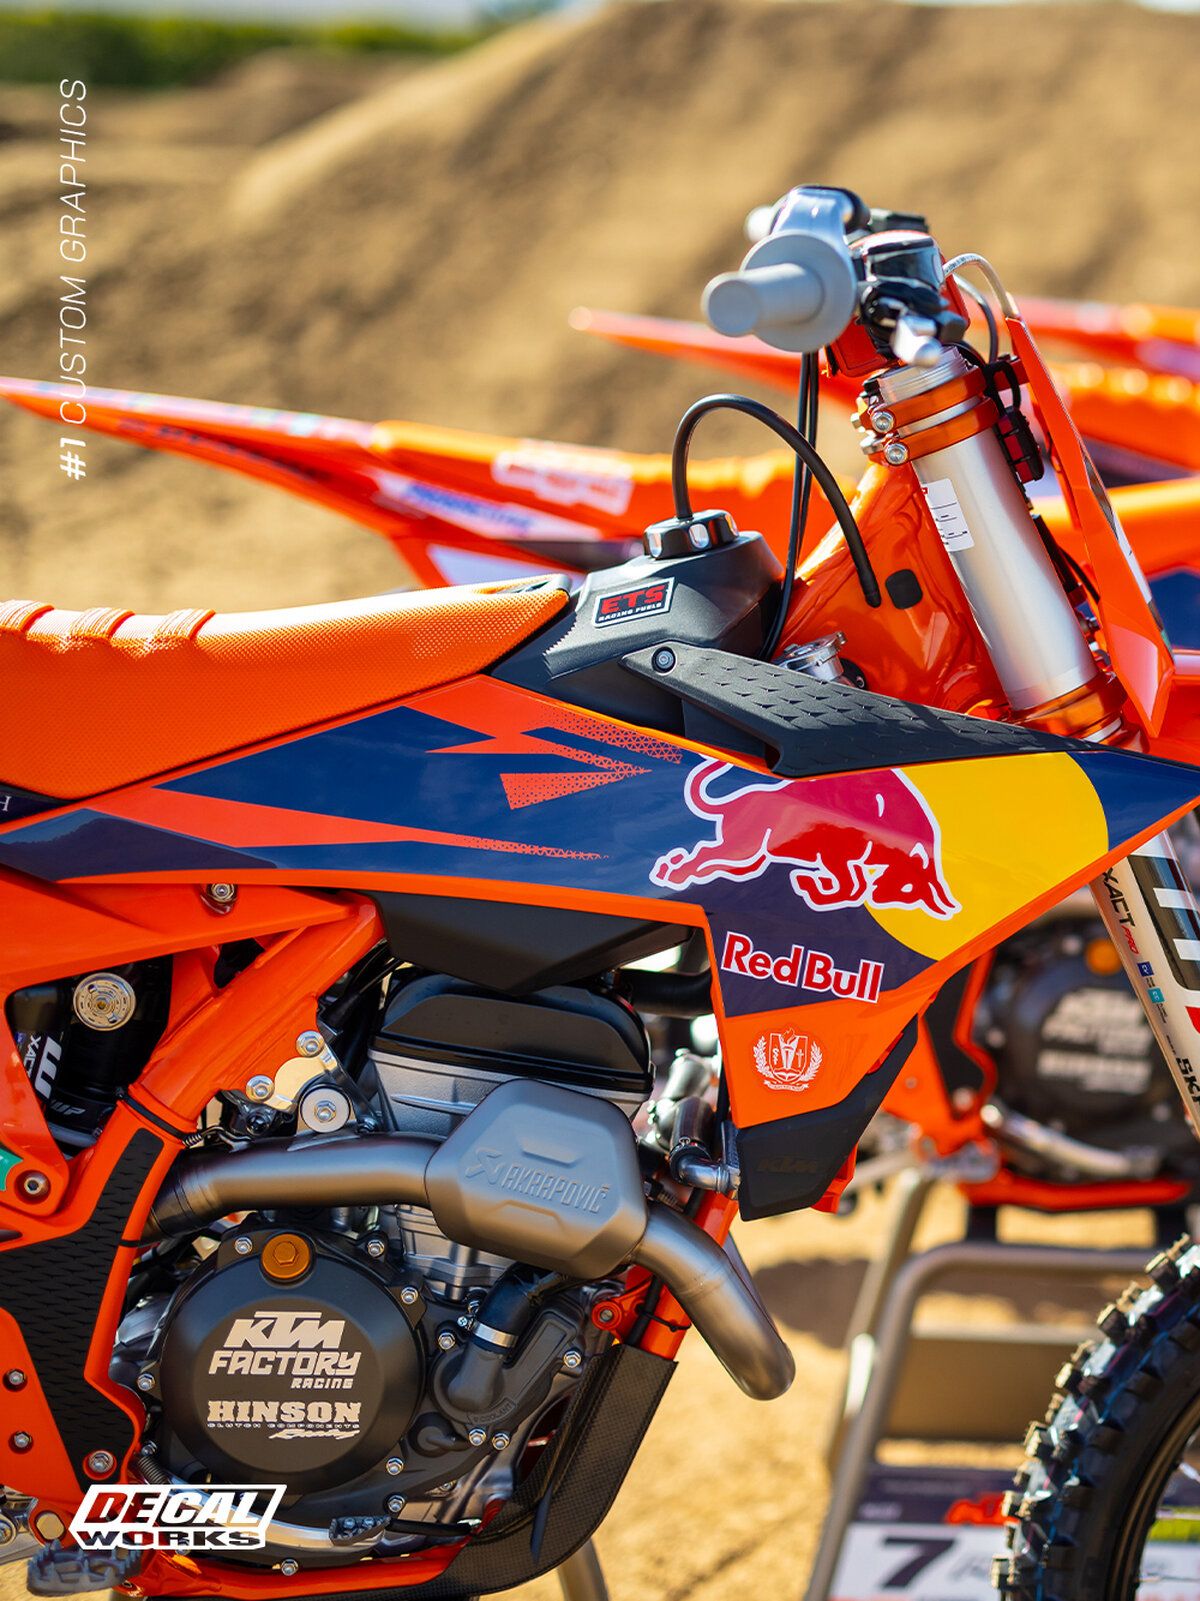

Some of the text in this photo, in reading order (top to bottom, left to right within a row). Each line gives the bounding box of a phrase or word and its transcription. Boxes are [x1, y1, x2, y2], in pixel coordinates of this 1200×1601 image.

[601, 585, 665, 614] ETS
[721, 931, 885, 1004] Red Bull
[223, 1311, 346, 1349] KTM
[208, 1351, 362, 1376] FACTORY
[290, 1378, 355, 1389] RACING
[207, 1401, 362, 1423] HINSON
[881, 1537, 957, 1590] 7
